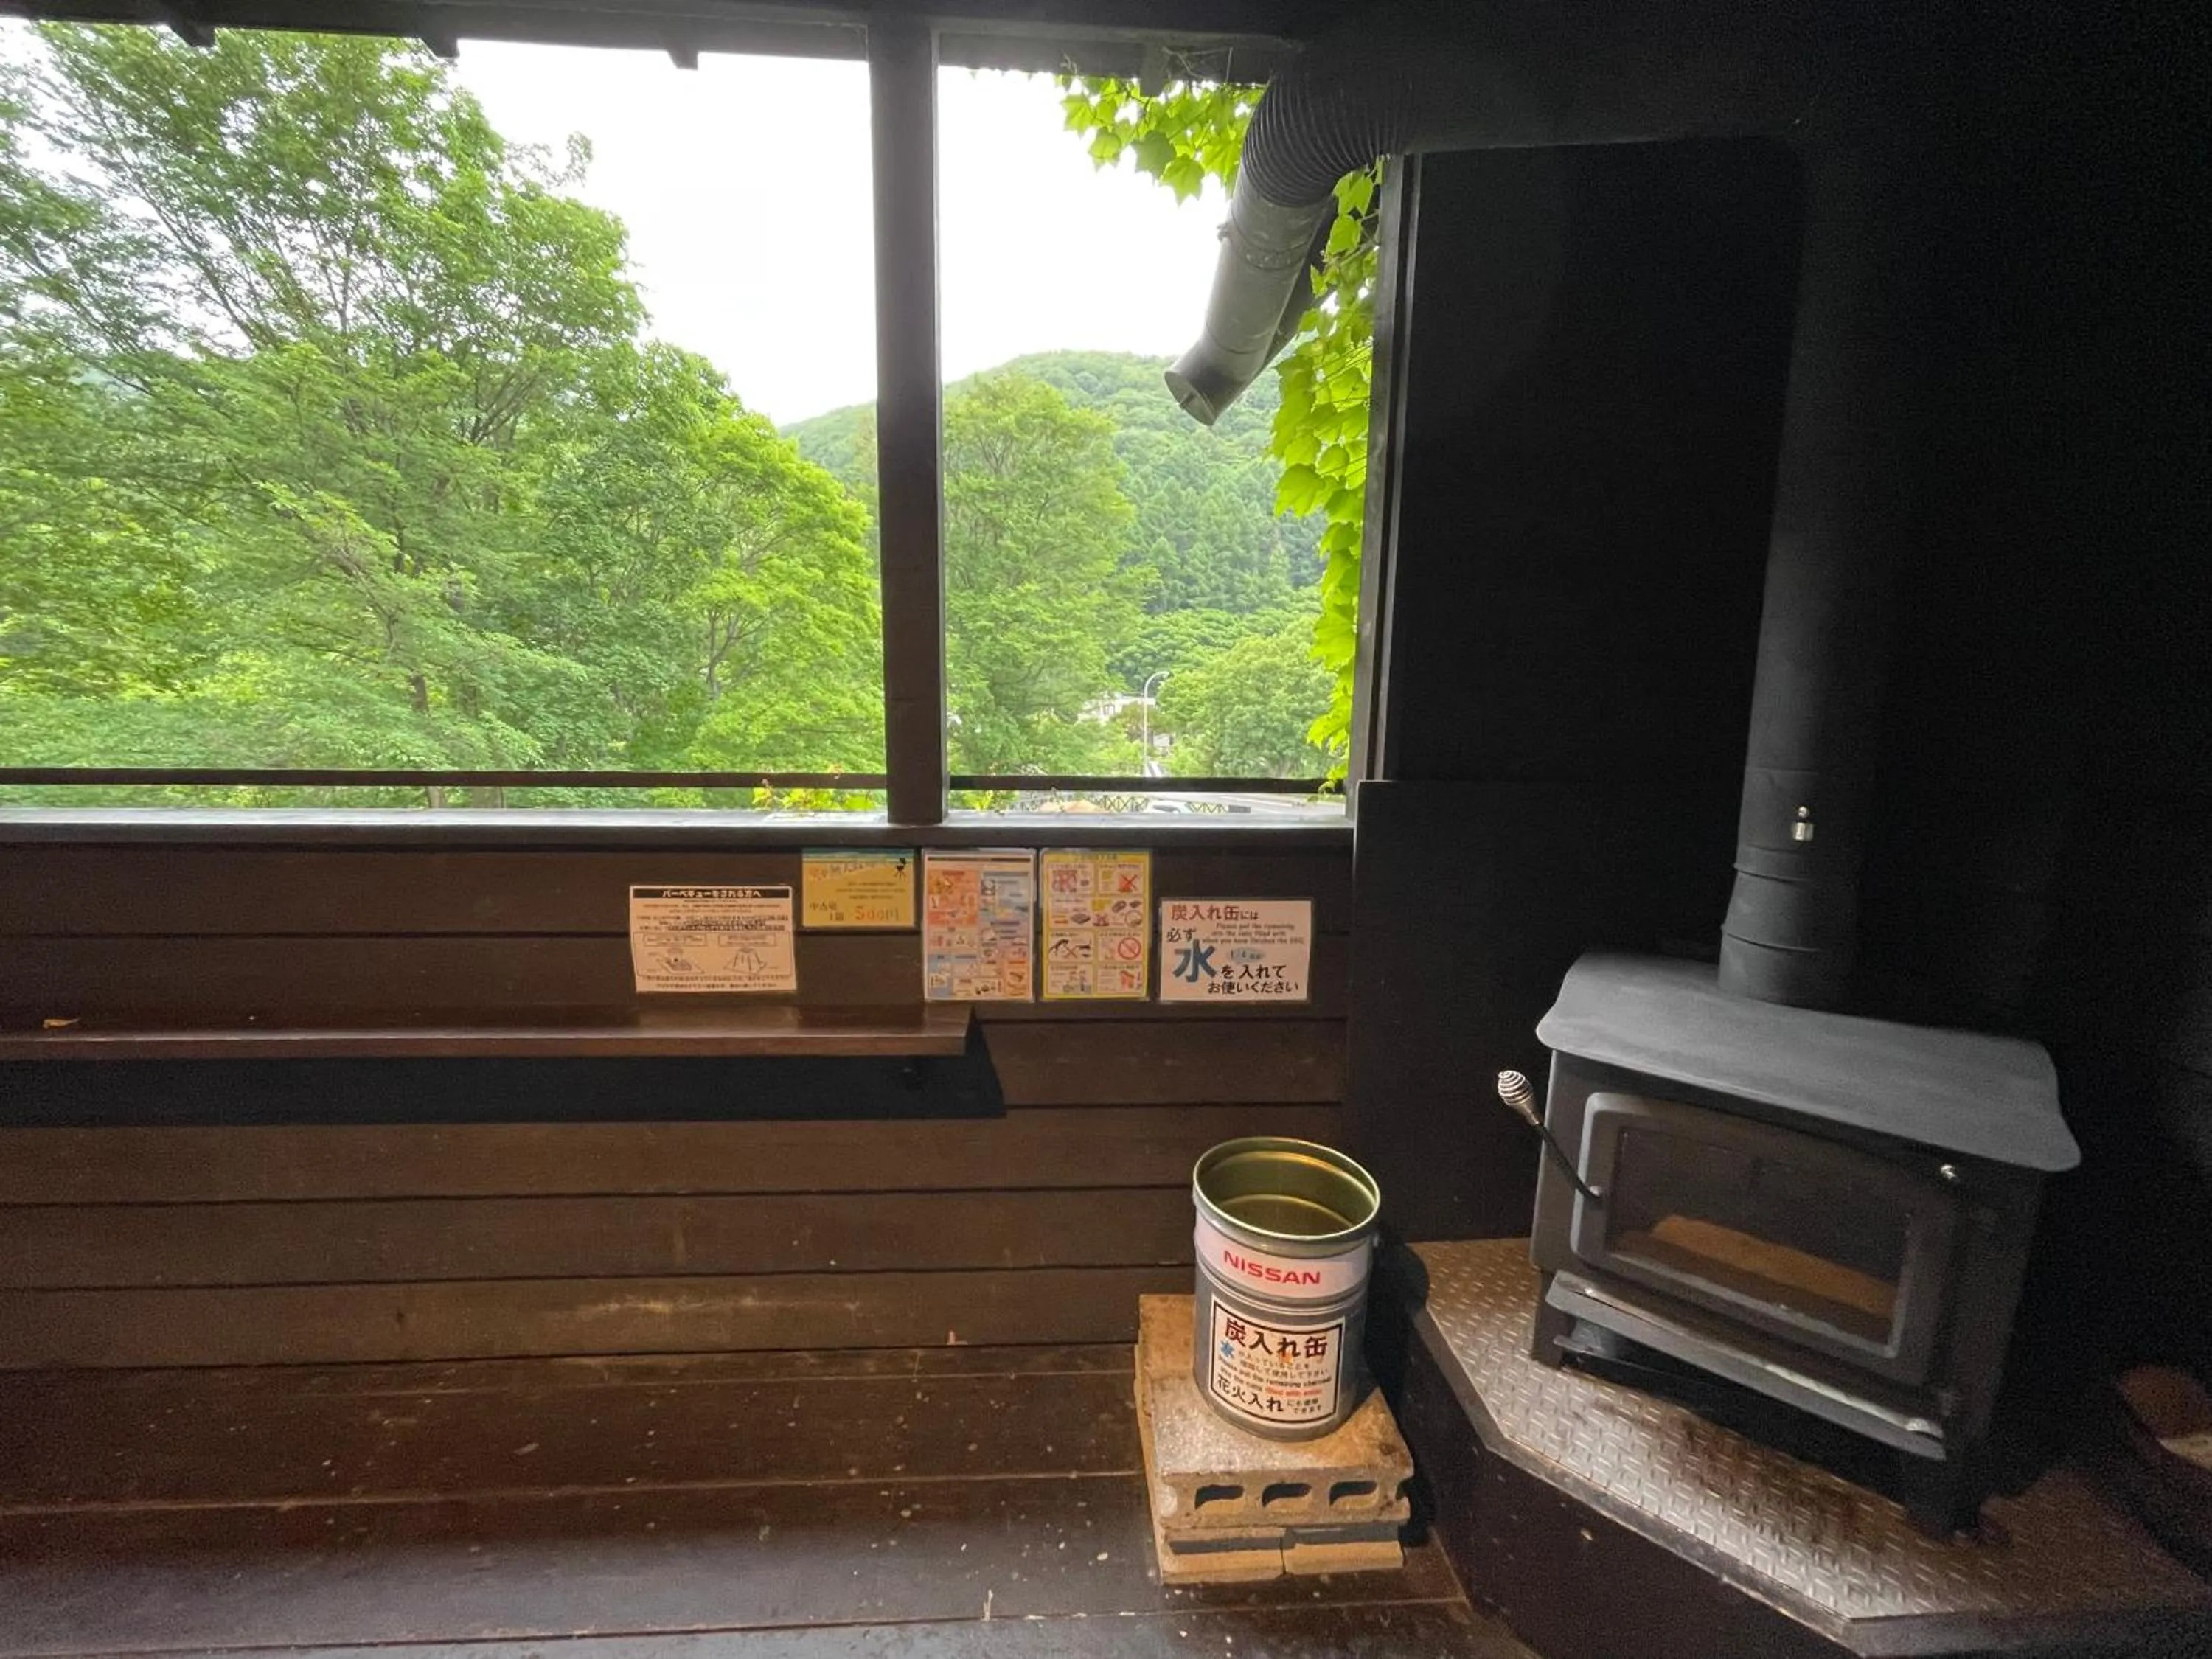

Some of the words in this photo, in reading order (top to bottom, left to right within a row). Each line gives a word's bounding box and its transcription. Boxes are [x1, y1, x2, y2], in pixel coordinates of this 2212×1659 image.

[662, 889, 762, 898] バーベキューをされる方へ
[1171, 905, 1259, 921] 炭入れ缶には
[1166, 928, 1196, 943] 必ず
[1172, 939, 1217, 983] 水
[1221, 964, 1287, 980] を入れて
[1208, 981, 1298, 994] お使いください
[1223, 1251, 1321, 1285] NISSAN
[1225, 1317, 1328, 1358] 炭入れ缶
[1217, 1374, 1284, 1412] 花火入れ
